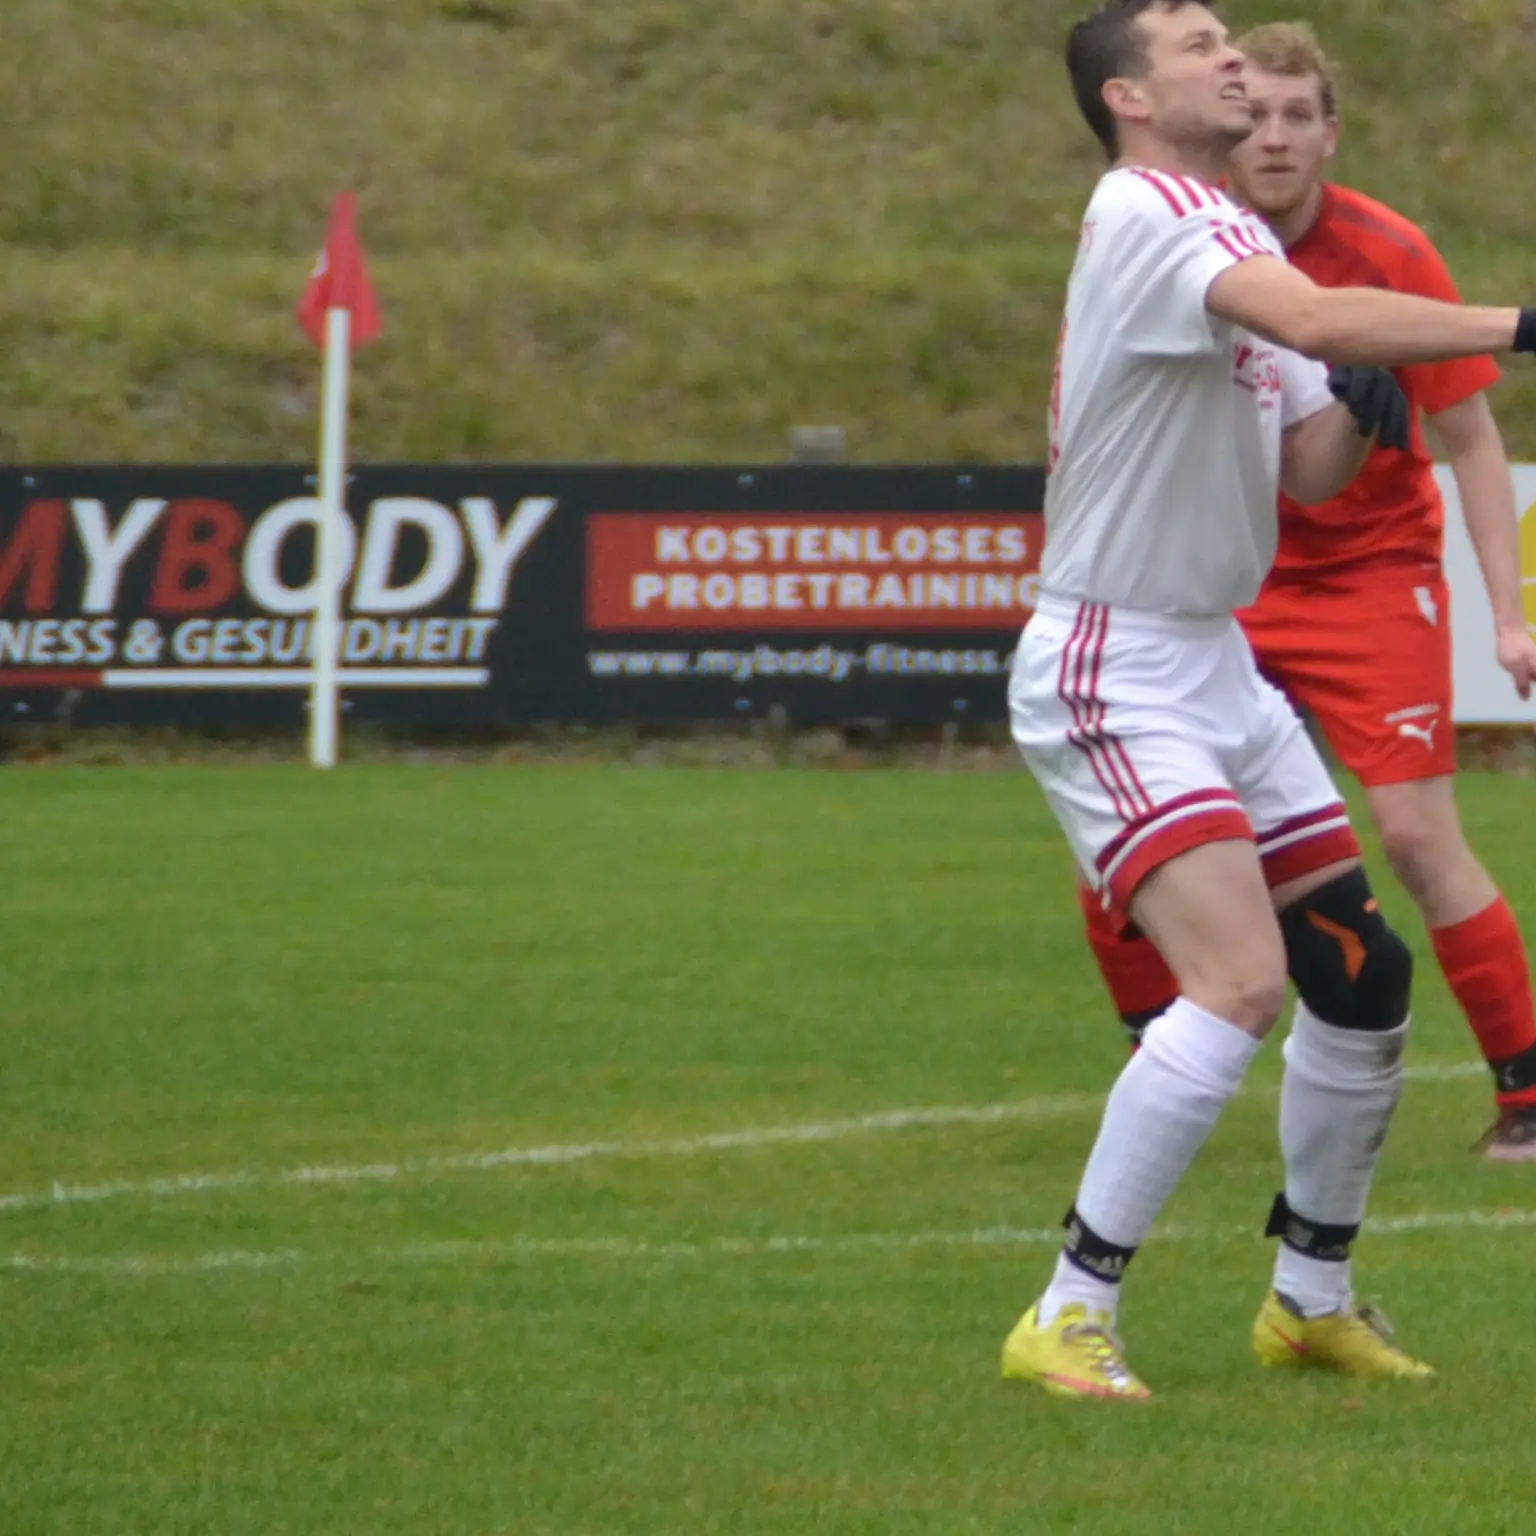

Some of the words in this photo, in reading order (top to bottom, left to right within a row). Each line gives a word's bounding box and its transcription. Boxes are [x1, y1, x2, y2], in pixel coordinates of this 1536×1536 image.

[656, 526, 1027, 564] KOSTENLOSES
[123, 619, 164, 664] &
[171, 617, 498, 663] GESUDHEIT
